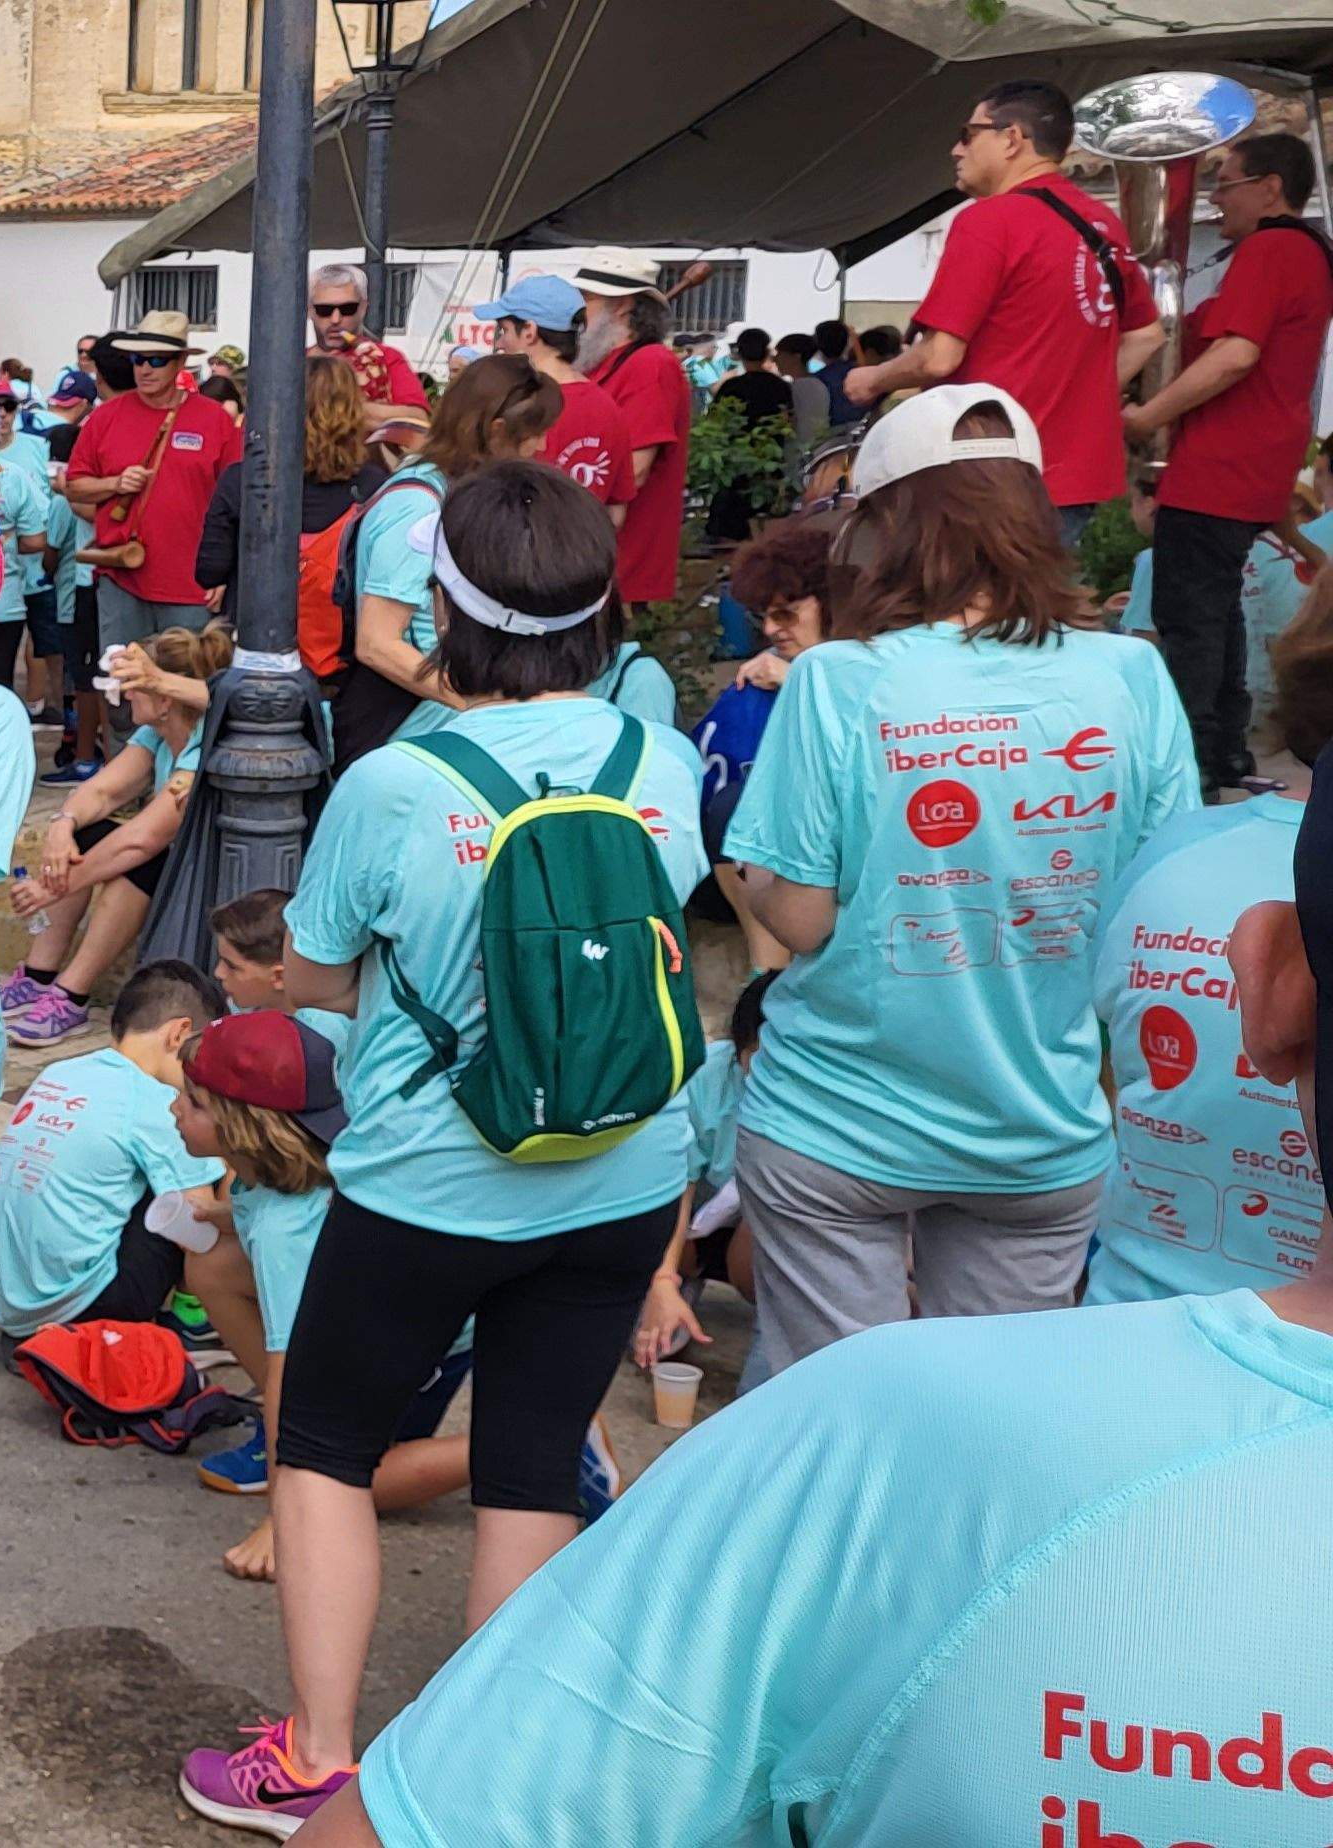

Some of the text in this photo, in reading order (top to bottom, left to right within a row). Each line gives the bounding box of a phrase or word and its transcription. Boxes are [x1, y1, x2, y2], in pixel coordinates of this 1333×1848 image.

[879, 711, 1019, 742] Fundación
[885, 741, 1029, 773] iberCaja
[1133, 925, 1233, 957] Fundaci
[1129, 959, 1239, 1011] iberCaj
[1238, 1087, 1301, 1110] Automoto
[1233, 1147, 1324, 1185] escane
